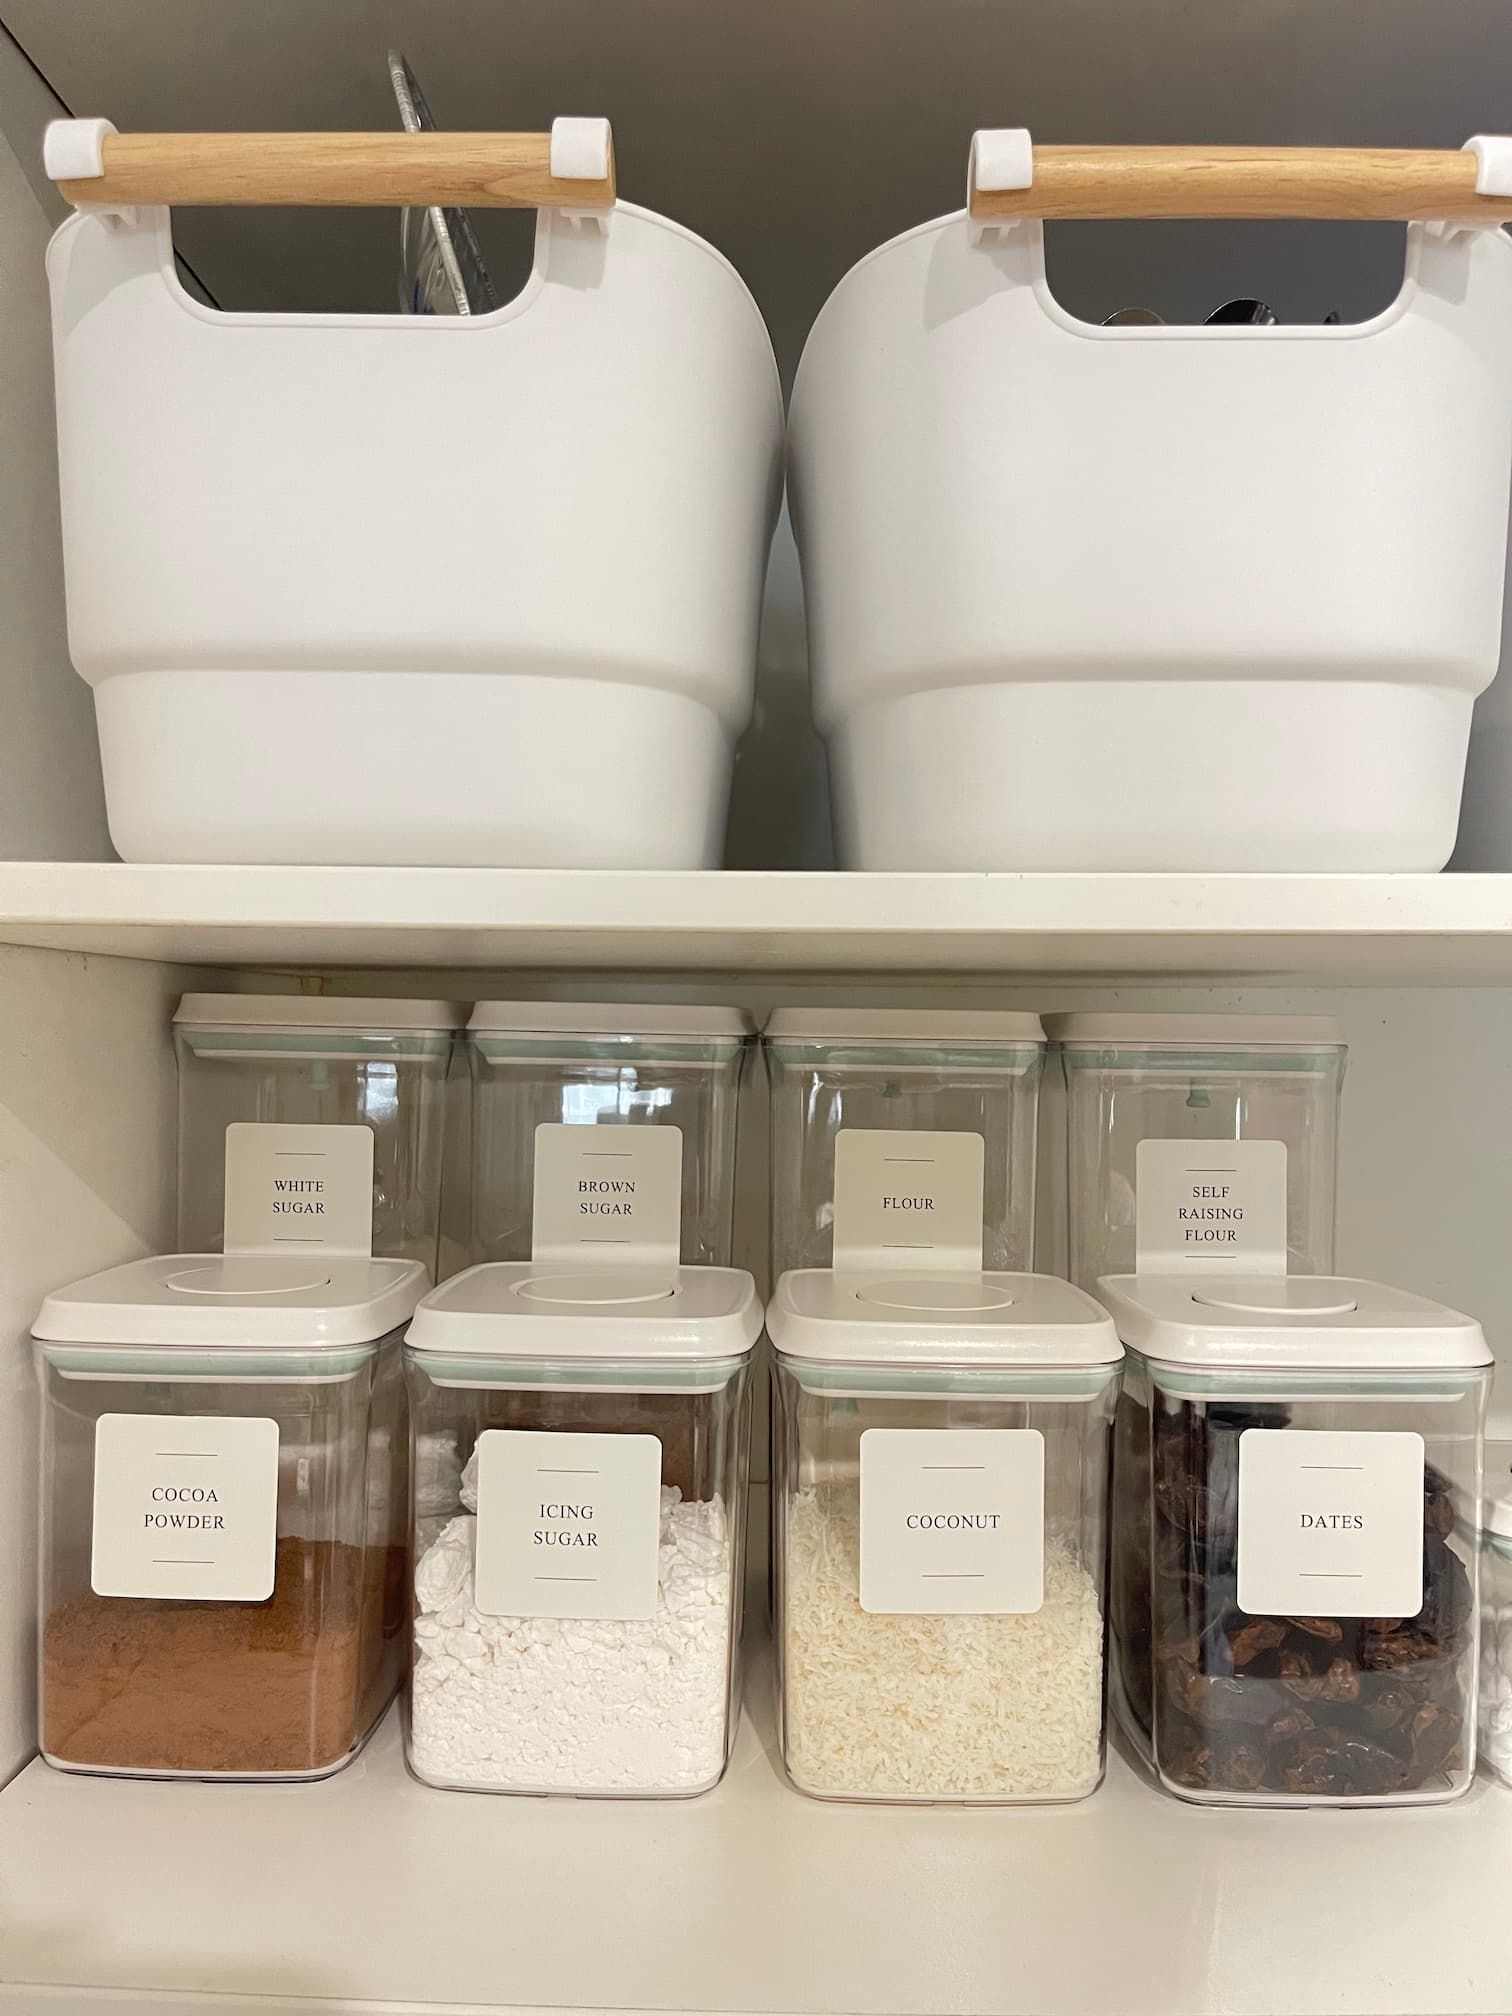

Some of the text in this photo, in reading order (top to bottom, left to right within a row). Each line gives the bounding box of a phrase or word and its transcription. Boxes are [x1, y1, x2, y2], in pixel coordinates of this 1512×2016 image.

[273, 1179, 324, 1193] WHITE
[578, 1180, 636, 1193] BROWN
[1191, 1185, 1230, 1199] SELF
[272, 1201, 324, 1215] SUGAR
[579, 1202, 633, 1216] SUGAR
[882, 1196, 935, 1210] FLOUR
[1178, 1207, 1244, 1220] RAISING
[1184, 1229, 1238, 1242] FLOUR
[151, 1487, 219, 1503] COCOA
[538, 1503, 594, 1520] ICING
[143, 1513, 226, 1530] POWDER
[906, 1514, 1001, 1530] COCONUT
[1300, 1514, 1364, 1530] DATES
[533, 1530, 599, 1547] SUGAR
